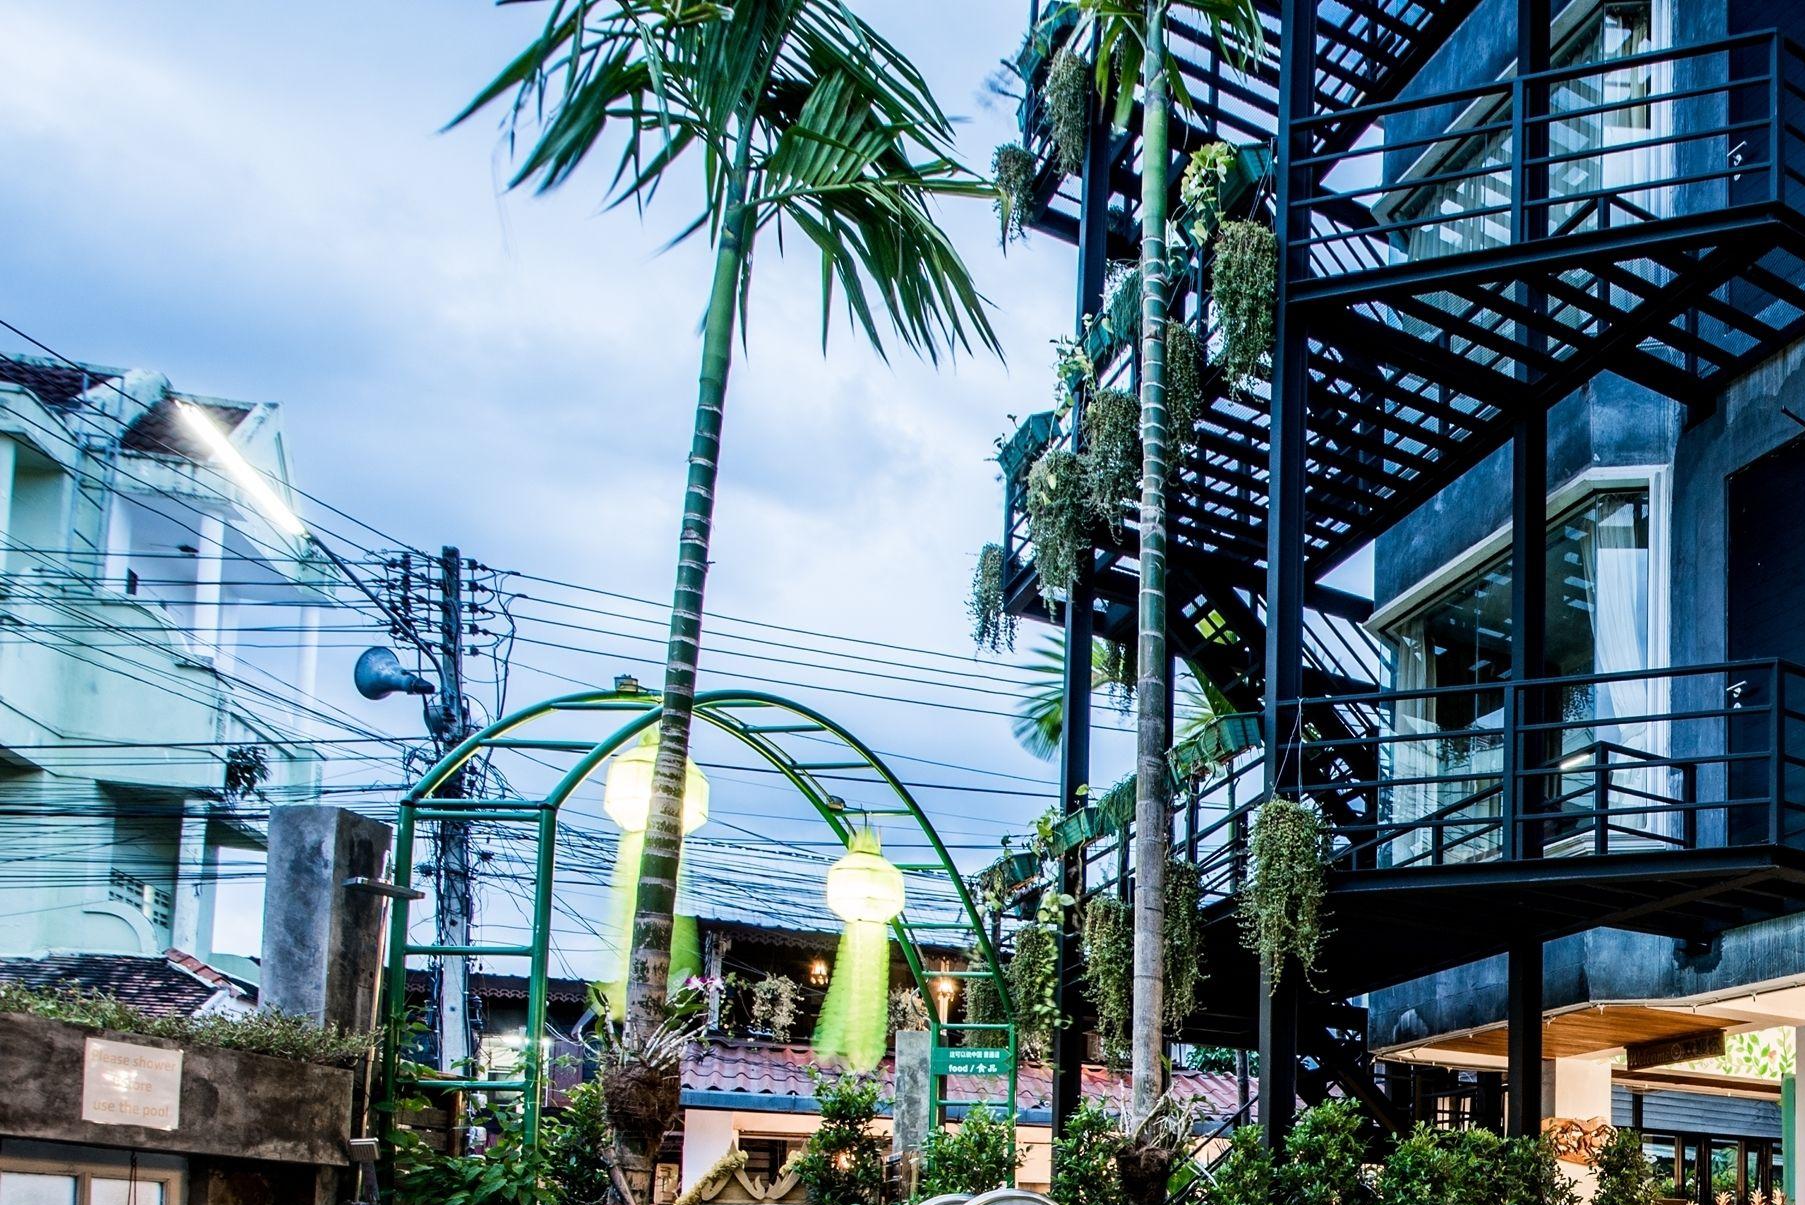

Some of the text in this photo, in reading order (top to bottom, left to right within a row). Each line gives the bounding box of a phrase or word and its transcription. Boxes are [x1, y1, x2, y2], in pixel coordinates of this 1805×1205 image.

[92, 1049, 176, 1072] Please shower
[948, 1064, 969, 1073] food
[976, 1063, 998, 1073] 食品
[92, 1101, 169, 1119] use the pool
